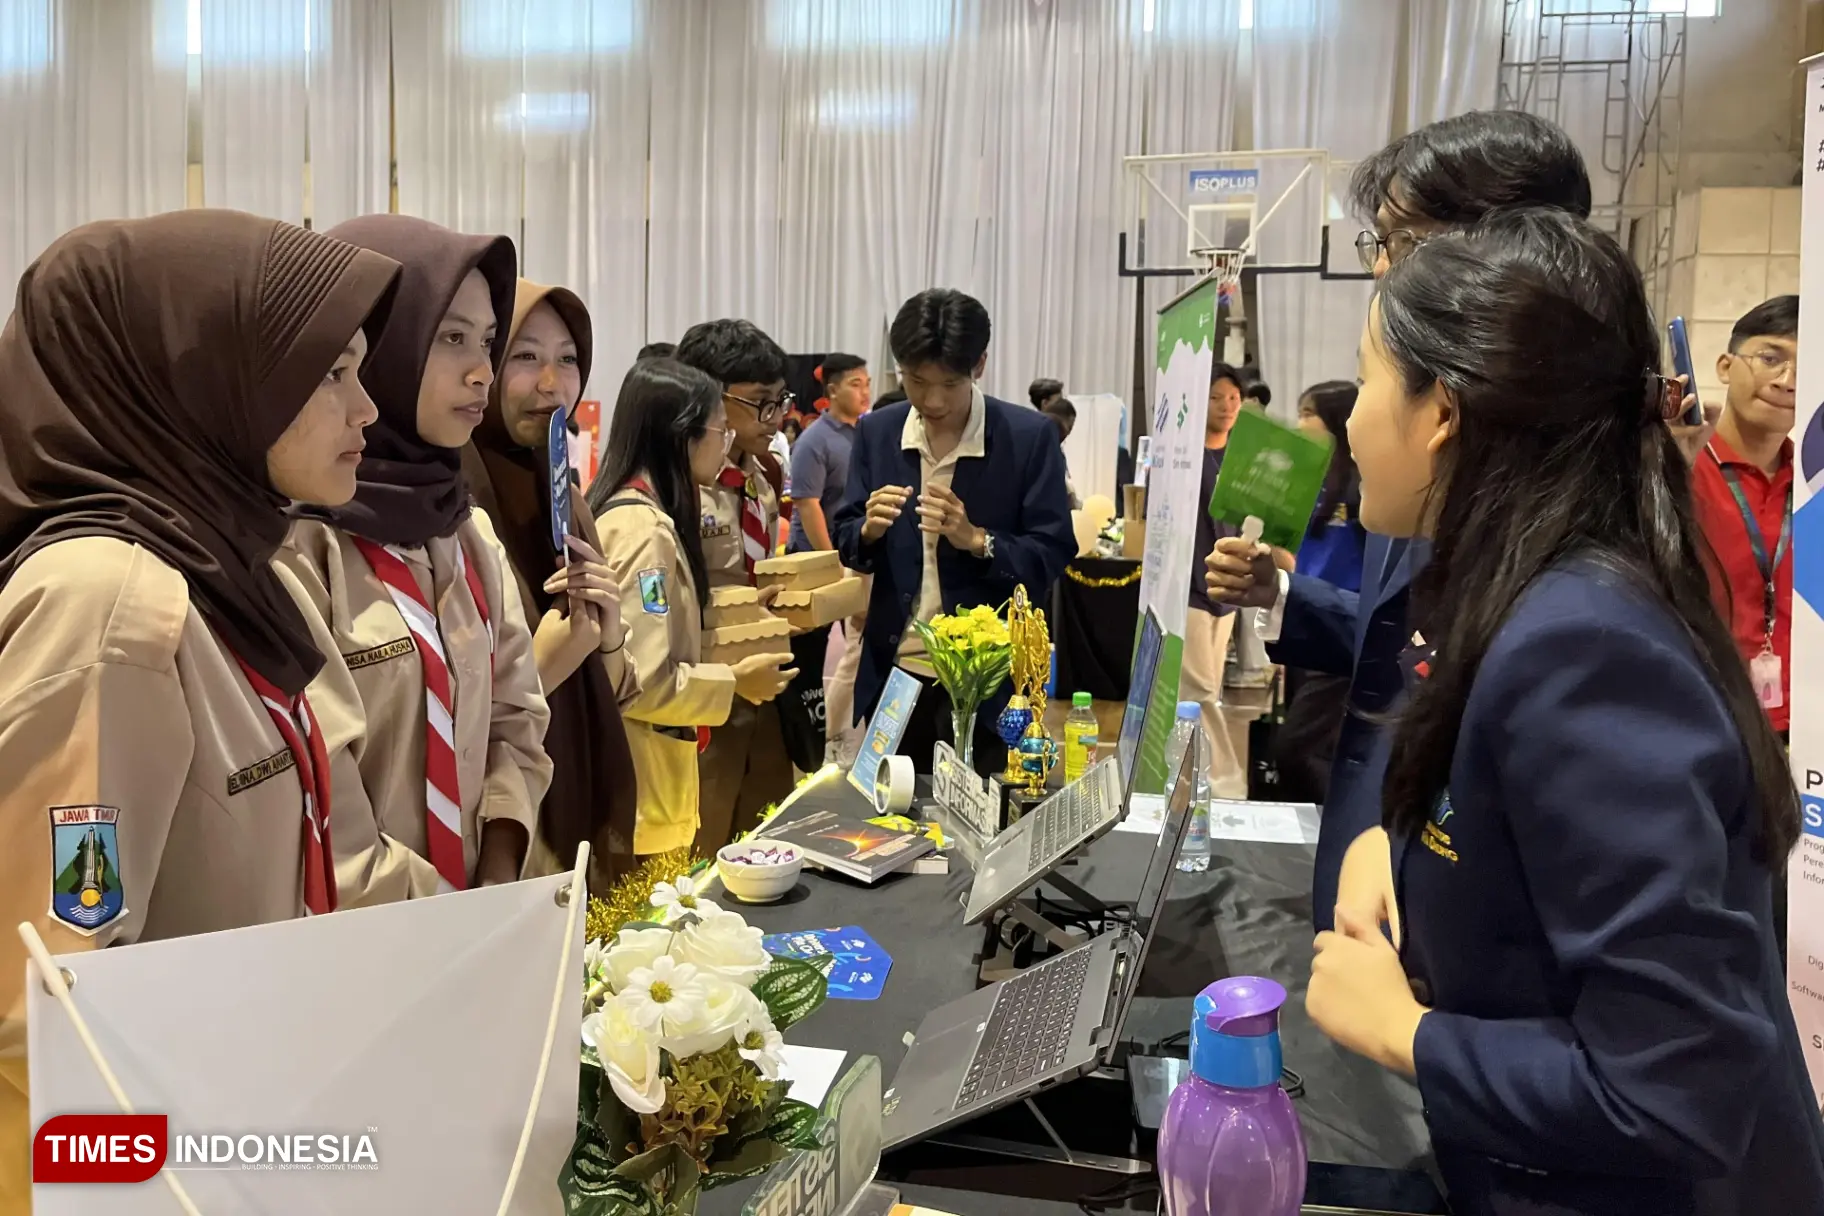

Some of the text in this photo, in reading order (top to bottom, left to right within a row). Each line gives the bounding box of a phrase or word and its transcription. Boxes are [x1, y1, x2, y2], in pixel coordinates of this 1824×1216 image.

[1194, 176, 1256, 192] ISOPLUS
[60, 808, 89, 823] JAWA
[1791, 980, 1824, 1002] Softwa
